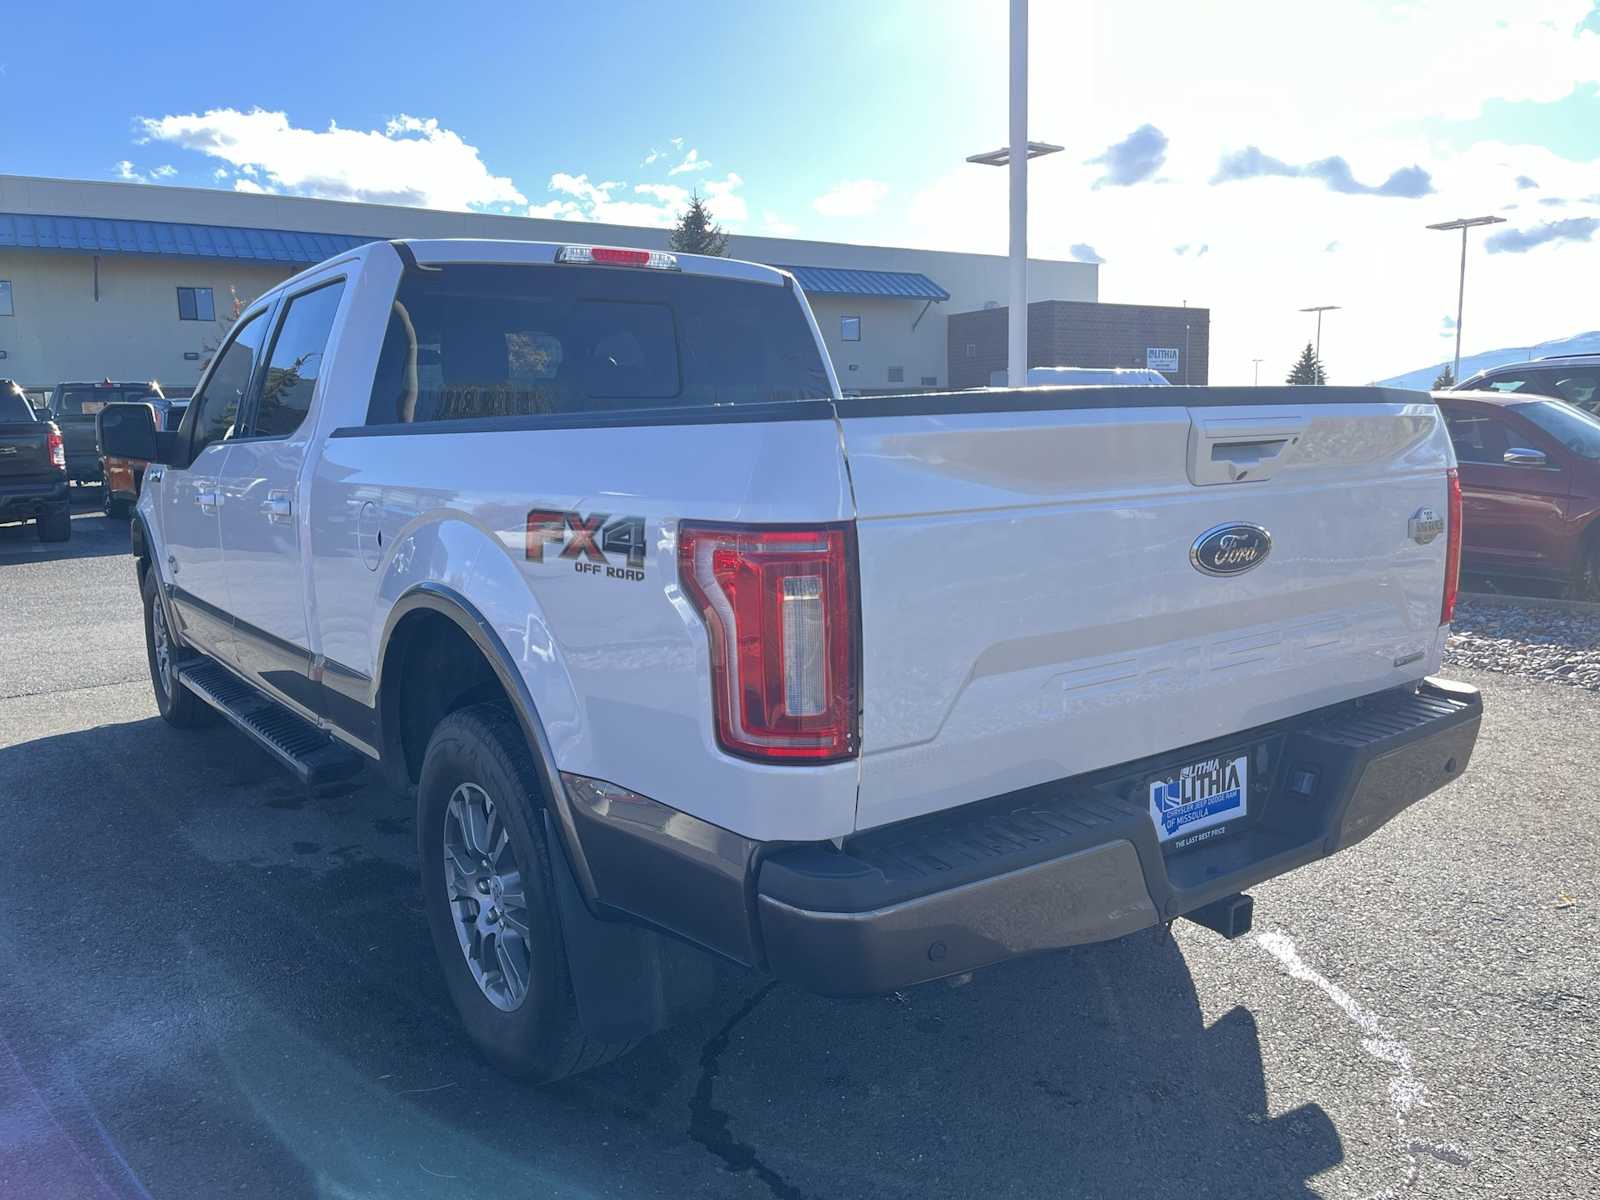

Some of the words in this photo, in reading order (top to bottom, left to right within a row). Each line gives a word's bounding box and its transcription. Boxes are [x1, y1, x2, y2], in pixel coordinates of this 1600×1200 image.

[525, 508, 646, 570] FX4
[1215, 534, 1258, 565] Ford
[574, 561, 601, 575] OFF
[606, 566, 645, 581] ROAD
[1190, 758, 1219, 777] LITHIA
[1181, 761, 1240, 805] LITHIA
[1166, 817, 1176, 829] OF
[1176, 807, 1209, 825] MISSOULA
[1185, 836, 1198, 846] LAST
